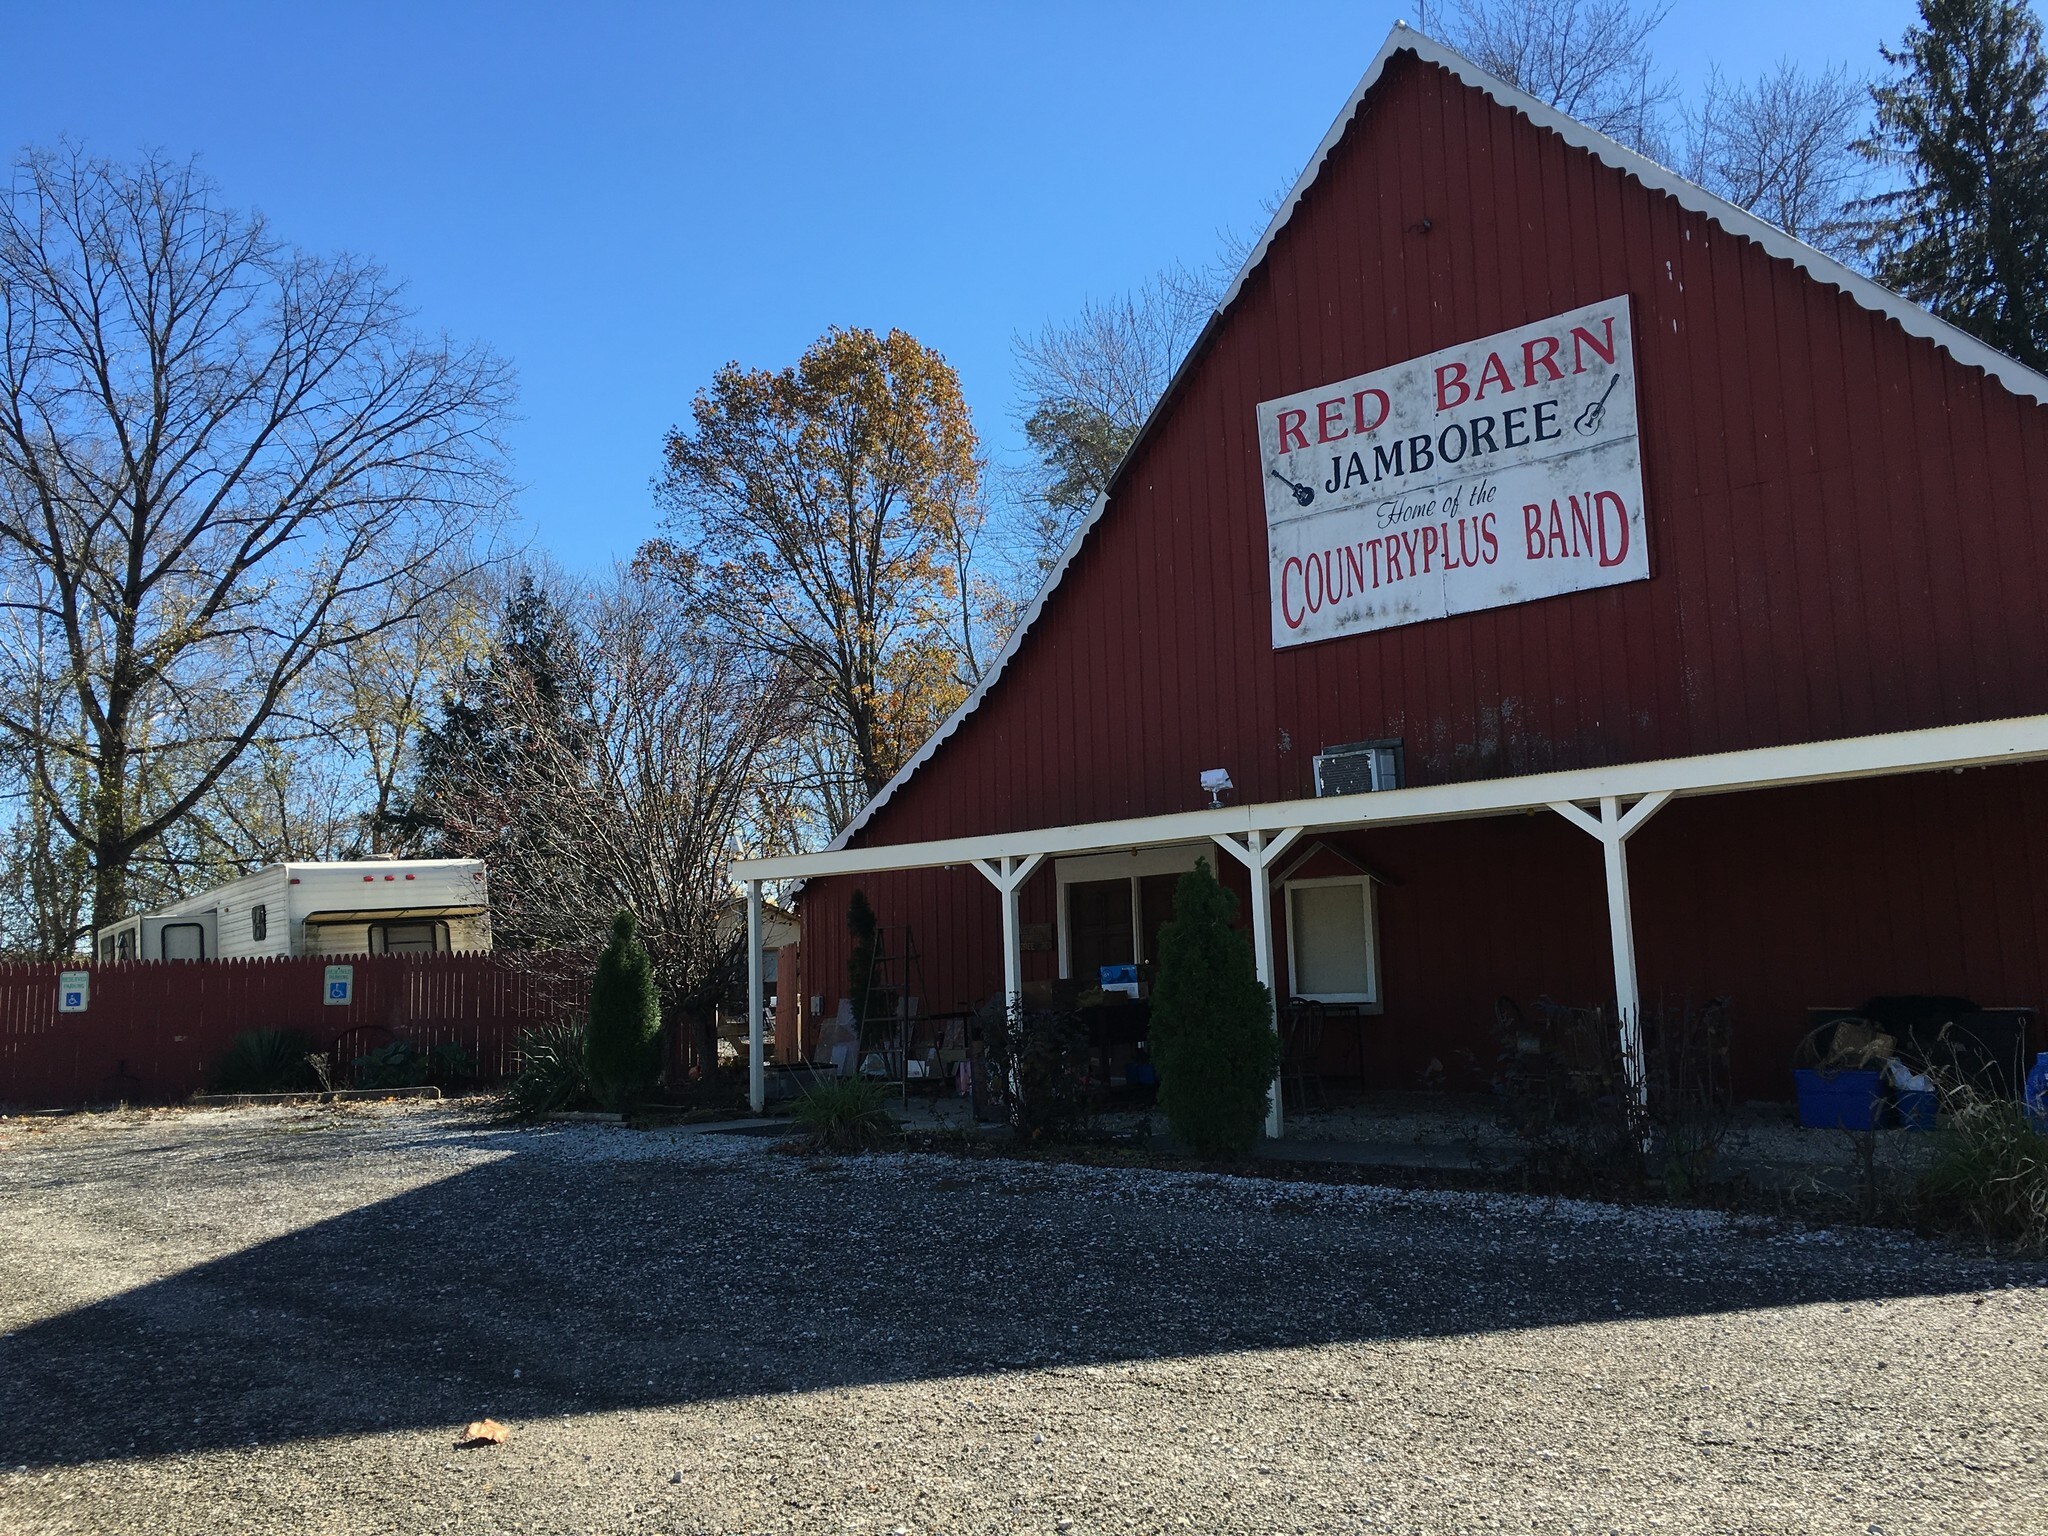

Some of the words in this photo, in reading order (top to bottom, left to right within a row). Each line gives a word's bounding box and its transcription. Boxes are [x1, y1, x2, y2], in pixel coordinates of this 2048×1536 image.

[1275, 387, 1391, 455] RED
[1434, 316, 1616, 413] BARN
[1324, 399, 1562, 494] JAMBOREE
[1377, 500, 1437, 530] Home
[1442, 484, 1464, 518] of
[1469, 478, 1497, 507] the
[1281, 512, 1499, 630] COUNTRYPLUS
[1522, 490, 1630, 568] BAND
